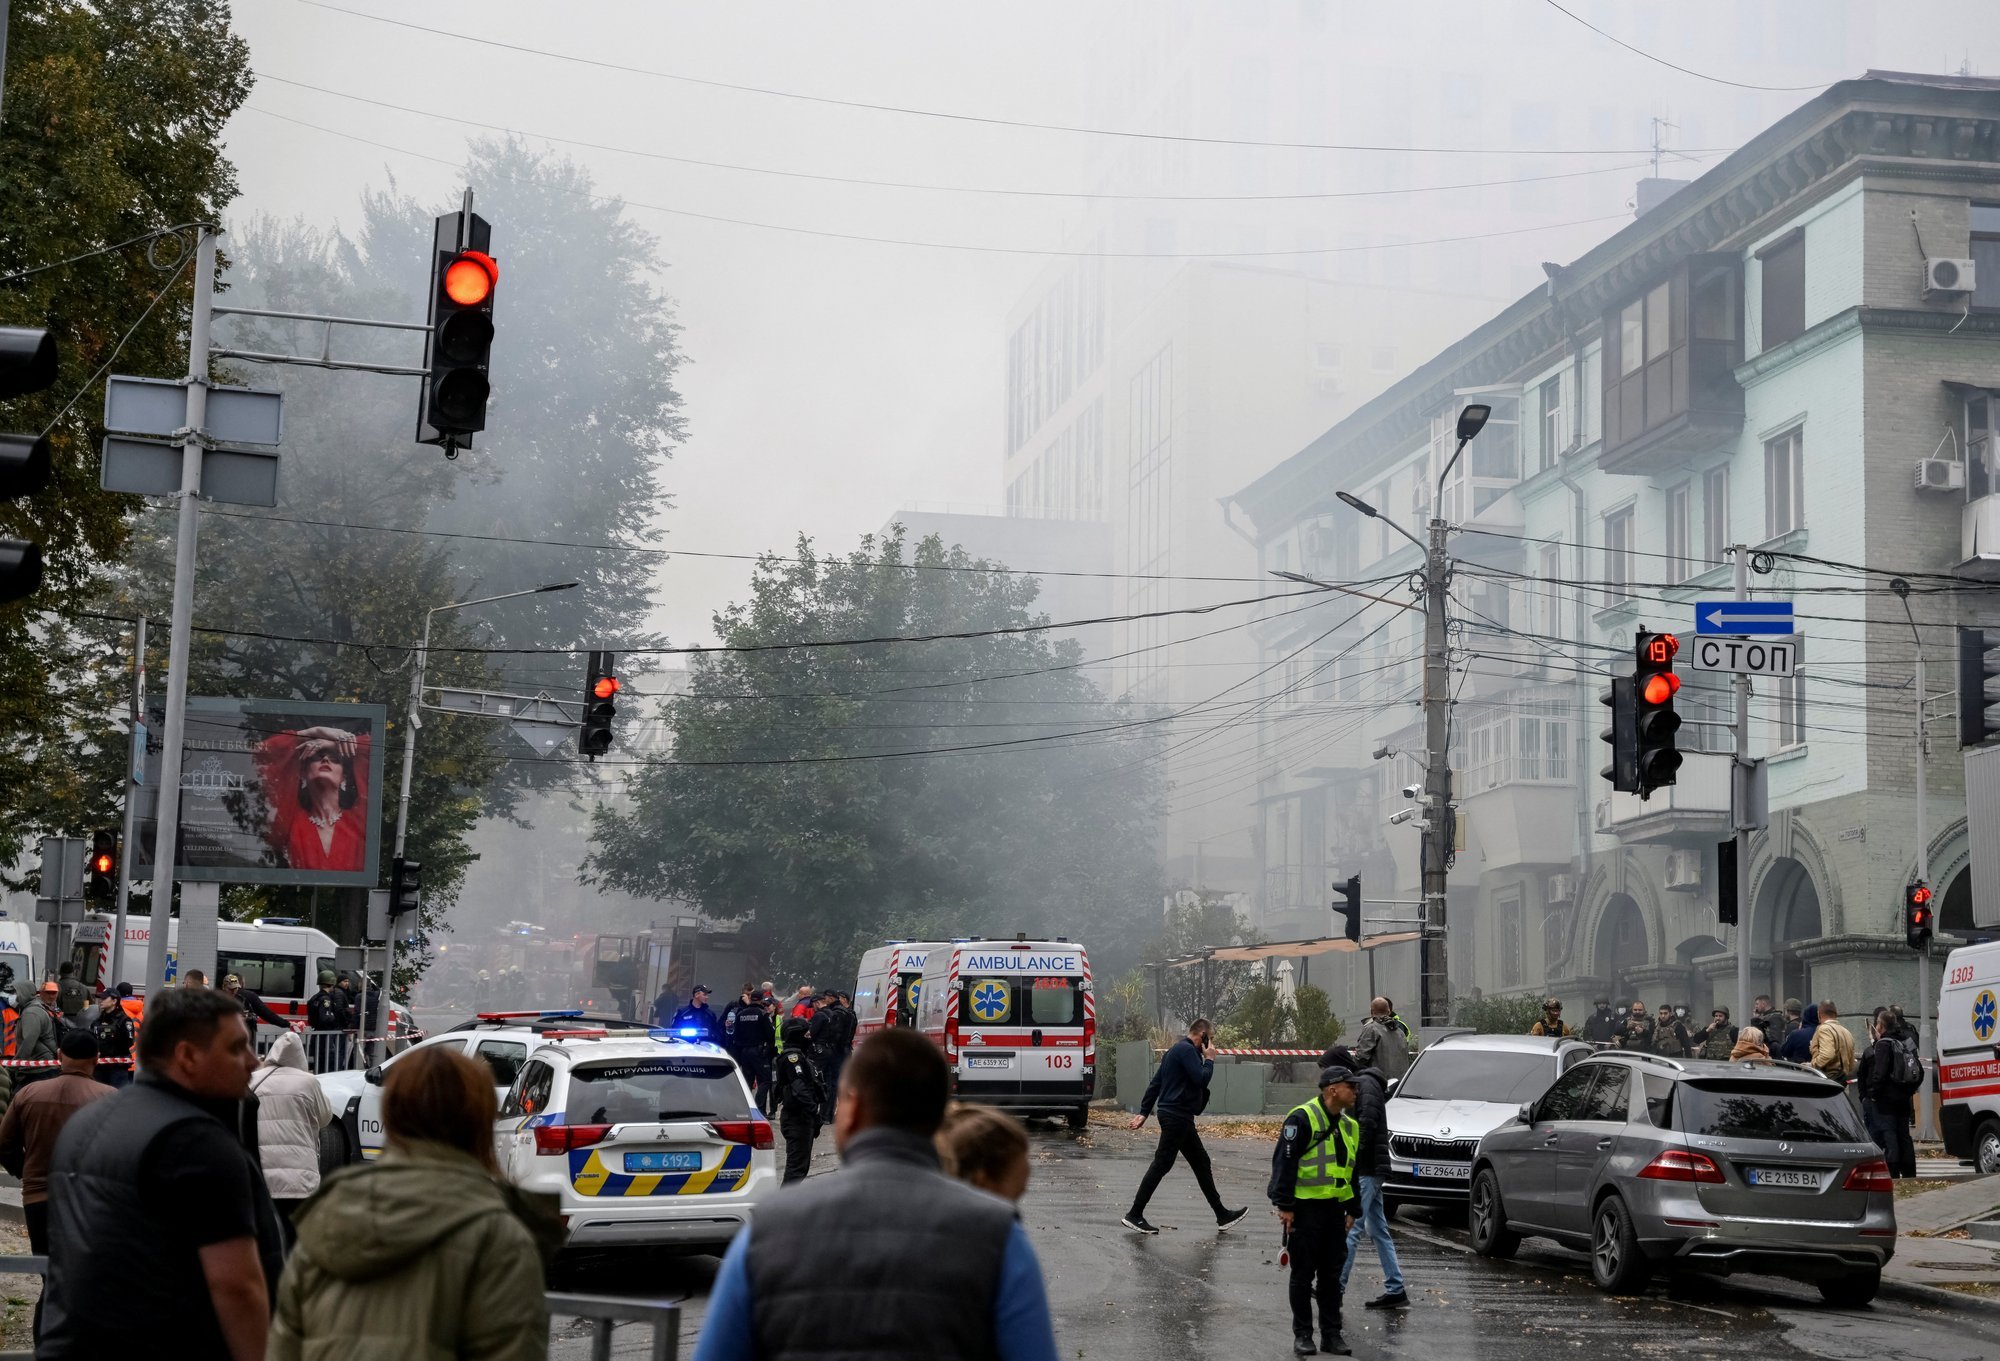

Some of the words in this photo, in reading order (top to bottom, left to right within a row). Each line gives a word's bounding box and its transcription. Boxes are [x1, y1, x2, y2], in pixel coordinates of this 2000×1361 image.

[1650, 642, 1666, 662] 19
[1701, 642, 1787, 672] СТОП
[180, 772, 244, 787] CELLINI
[967, 956, 1075, 970] AMBULANCE
[1950, 966, 1974, 984] 1303
[1045, 1055, 1072, 1068] 103
[604, 1065, 665, 1076] ПАТРУЛЬНА
[666, 1065, 706, 1074] ПОЛІЦІЯ
[1950, 1065, 1986, 1079] ЕКСТРЕНА
[662, 1154, 691, 1167] 6192
[1419, 1166, 1431, 1175] KE
[1433, 1167, 1454, 1176] 2964
[1457, 1168, 1470, 1177] AP
[1757, 1171, 1773, 1183] KE
[1775, 1172, 1799, 1184] 2135
[1802, 1174, 1818, 1185] BA
